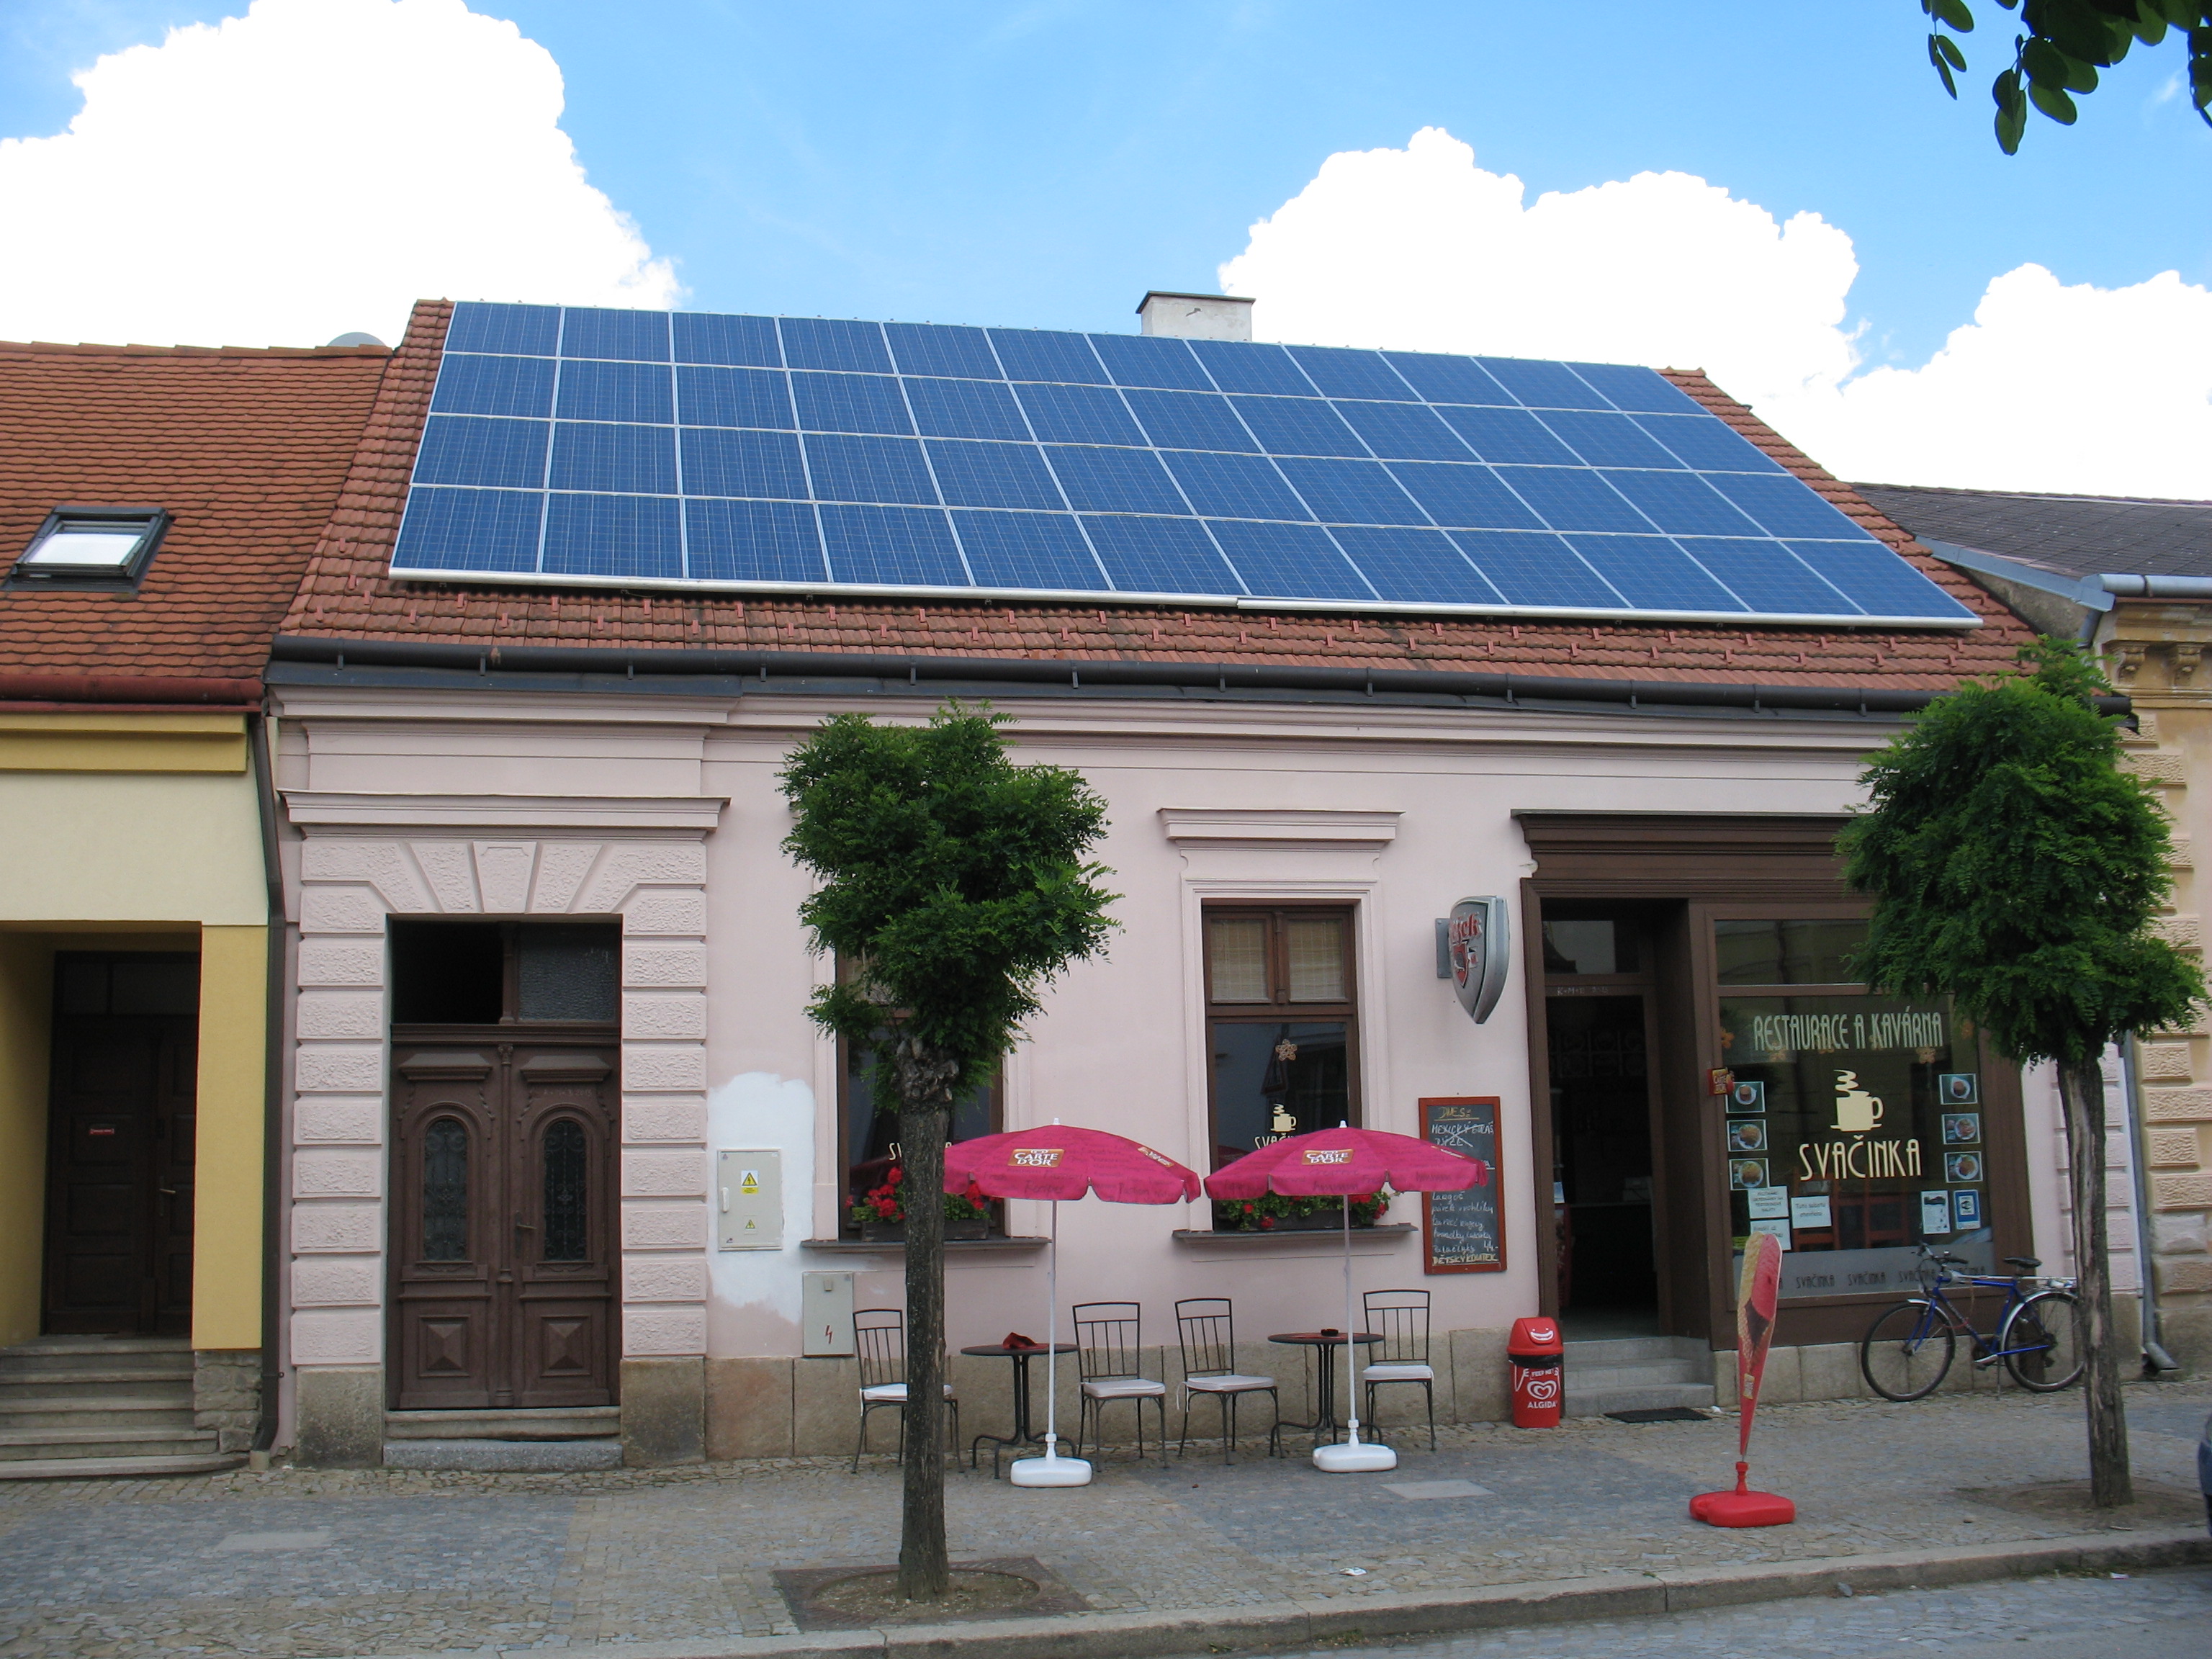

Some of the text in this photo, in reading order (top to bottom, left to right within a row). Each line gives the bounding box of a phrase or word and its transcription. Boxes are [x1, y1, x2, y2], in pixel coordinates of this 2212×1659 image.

[1753, 1005, 1943, 1051] RESTAURACE A KAVÁRNA
[1015, 1152, 1059, 1161] CARTE
[1799, 1135, 1922, 1182] SVAČINKA
[1527, 1401, 1557, 1409] ALGIDA
